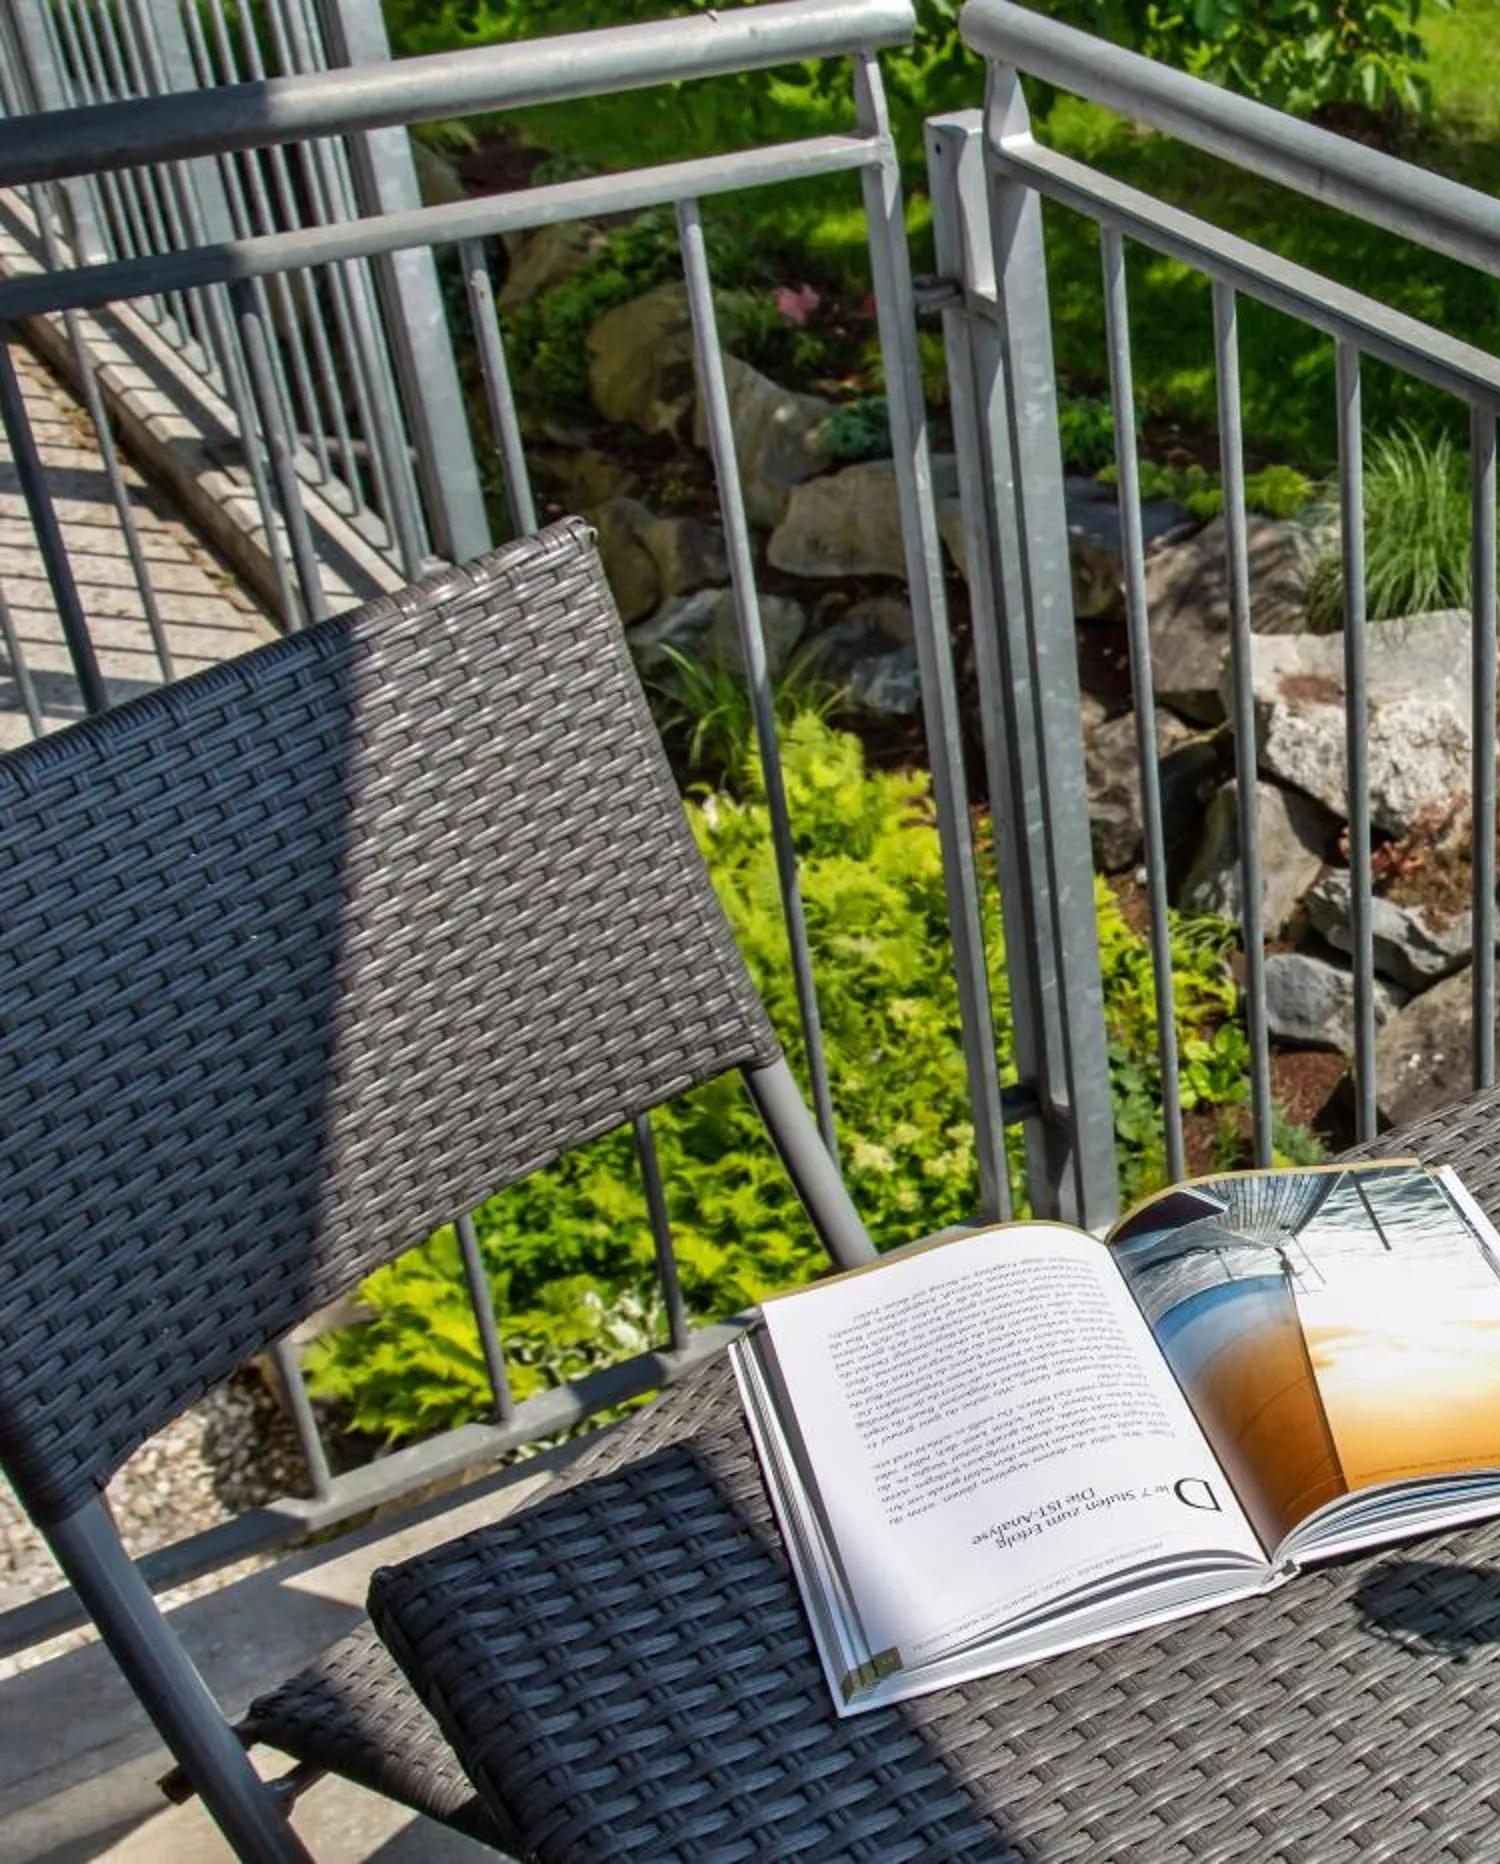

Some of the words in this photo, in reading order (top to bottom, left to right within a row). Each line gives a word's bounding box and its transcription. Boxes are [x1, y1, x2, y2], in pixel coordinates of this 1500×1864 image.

[1065, 1486, 1095, 1503] Die
[1086, 1488, 1137, 1512] Stufen
[1142, 1487, 1153, 1497] 7
[972, 1498, 1063, 1545] IST-Analyse
[1046, 1505, 1081, 1524] zum
[995, 1521, 1043, 1549] Erfolg
